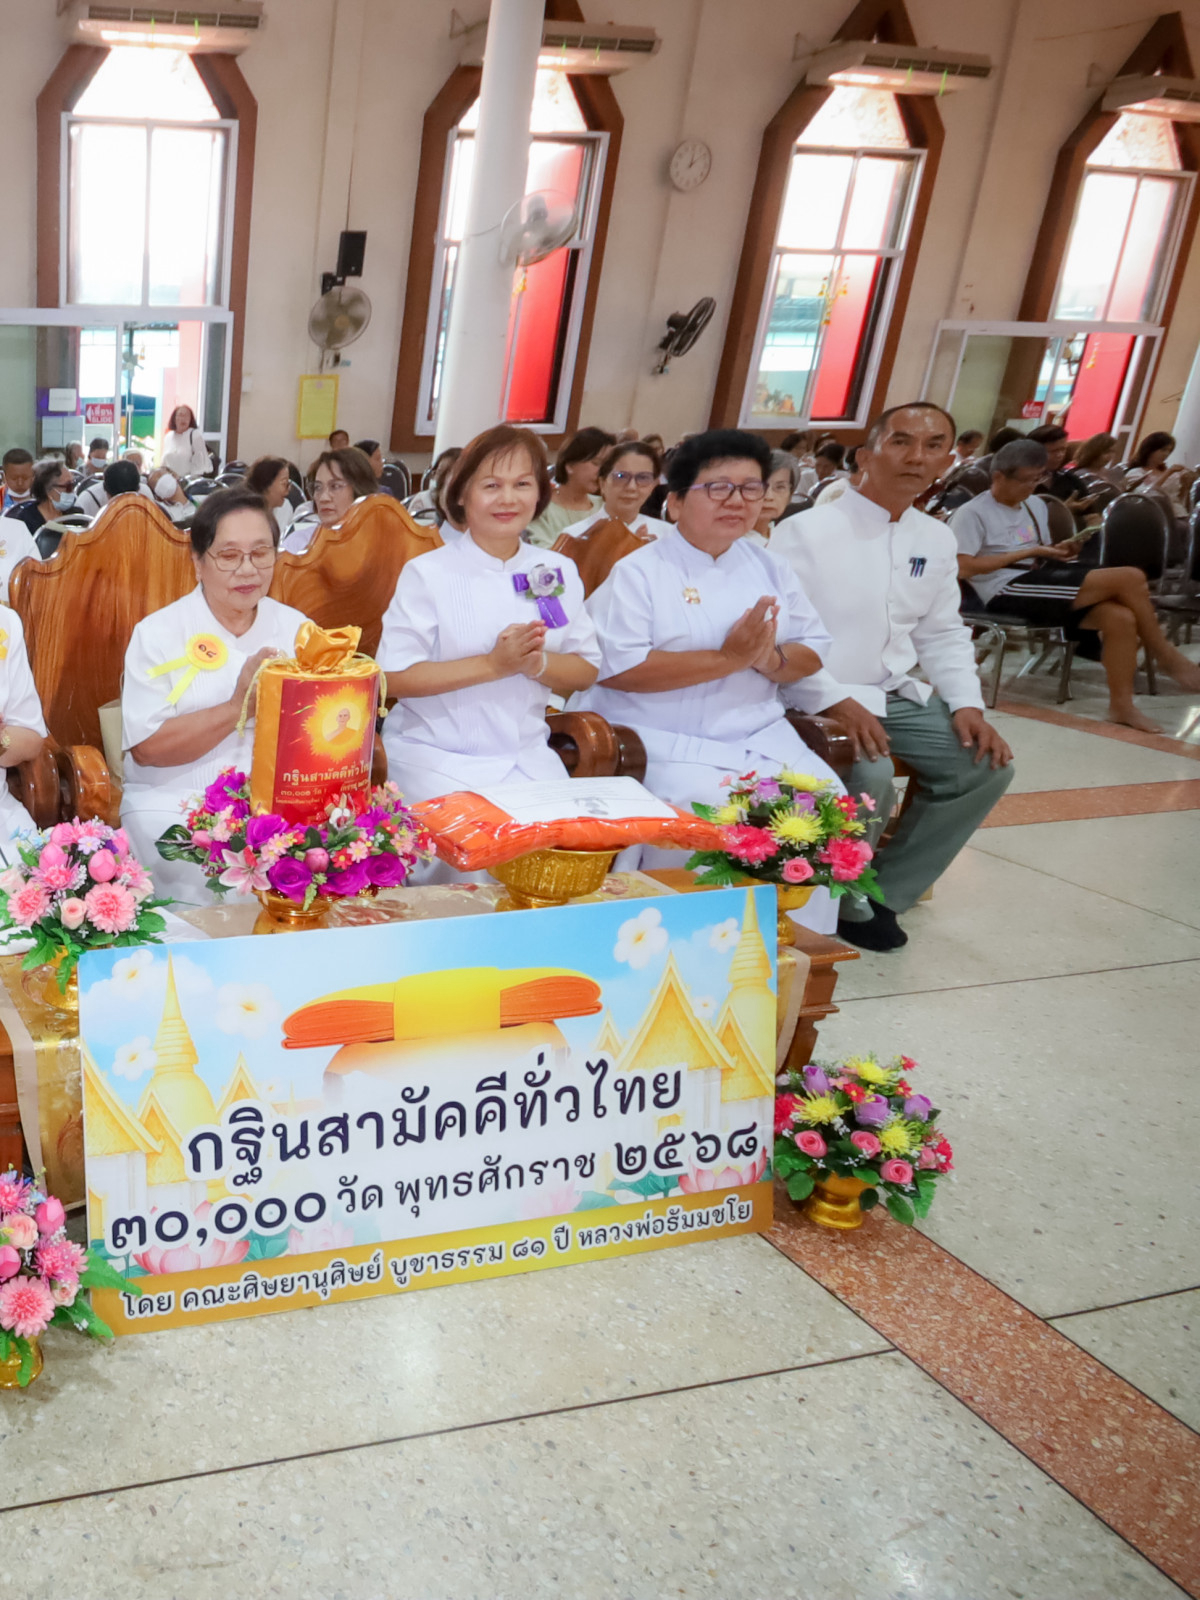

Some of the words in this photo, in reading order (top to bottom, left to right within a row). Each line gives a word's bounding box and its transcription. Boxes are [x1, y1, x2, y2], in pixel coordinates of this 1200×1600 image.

[188, 1052, 682, 1187] กฐินสามัคคีทั่วไทย
[111, 1193, 327, 1249] ๓๐,๐๐๐
[337, 1175, 383, 1213] วัด
[394, 1153, 596, 1218] พุทธศักราช
[614, 1121, 759, 1176] ๒๕๖๘
[122, 1291, 172, 1316] โดย
[183, 1252, 382, 1308] คณะศิษยานุศิษย์
[390, 1242, 503, 1285] บูชาธรรม
[513, 1239, 545, 1257] ๘๑
[553, 1225, 569, 1250] ปี
[578, 1198, 751, 1247] หลวงพ่อธัมมชโย
